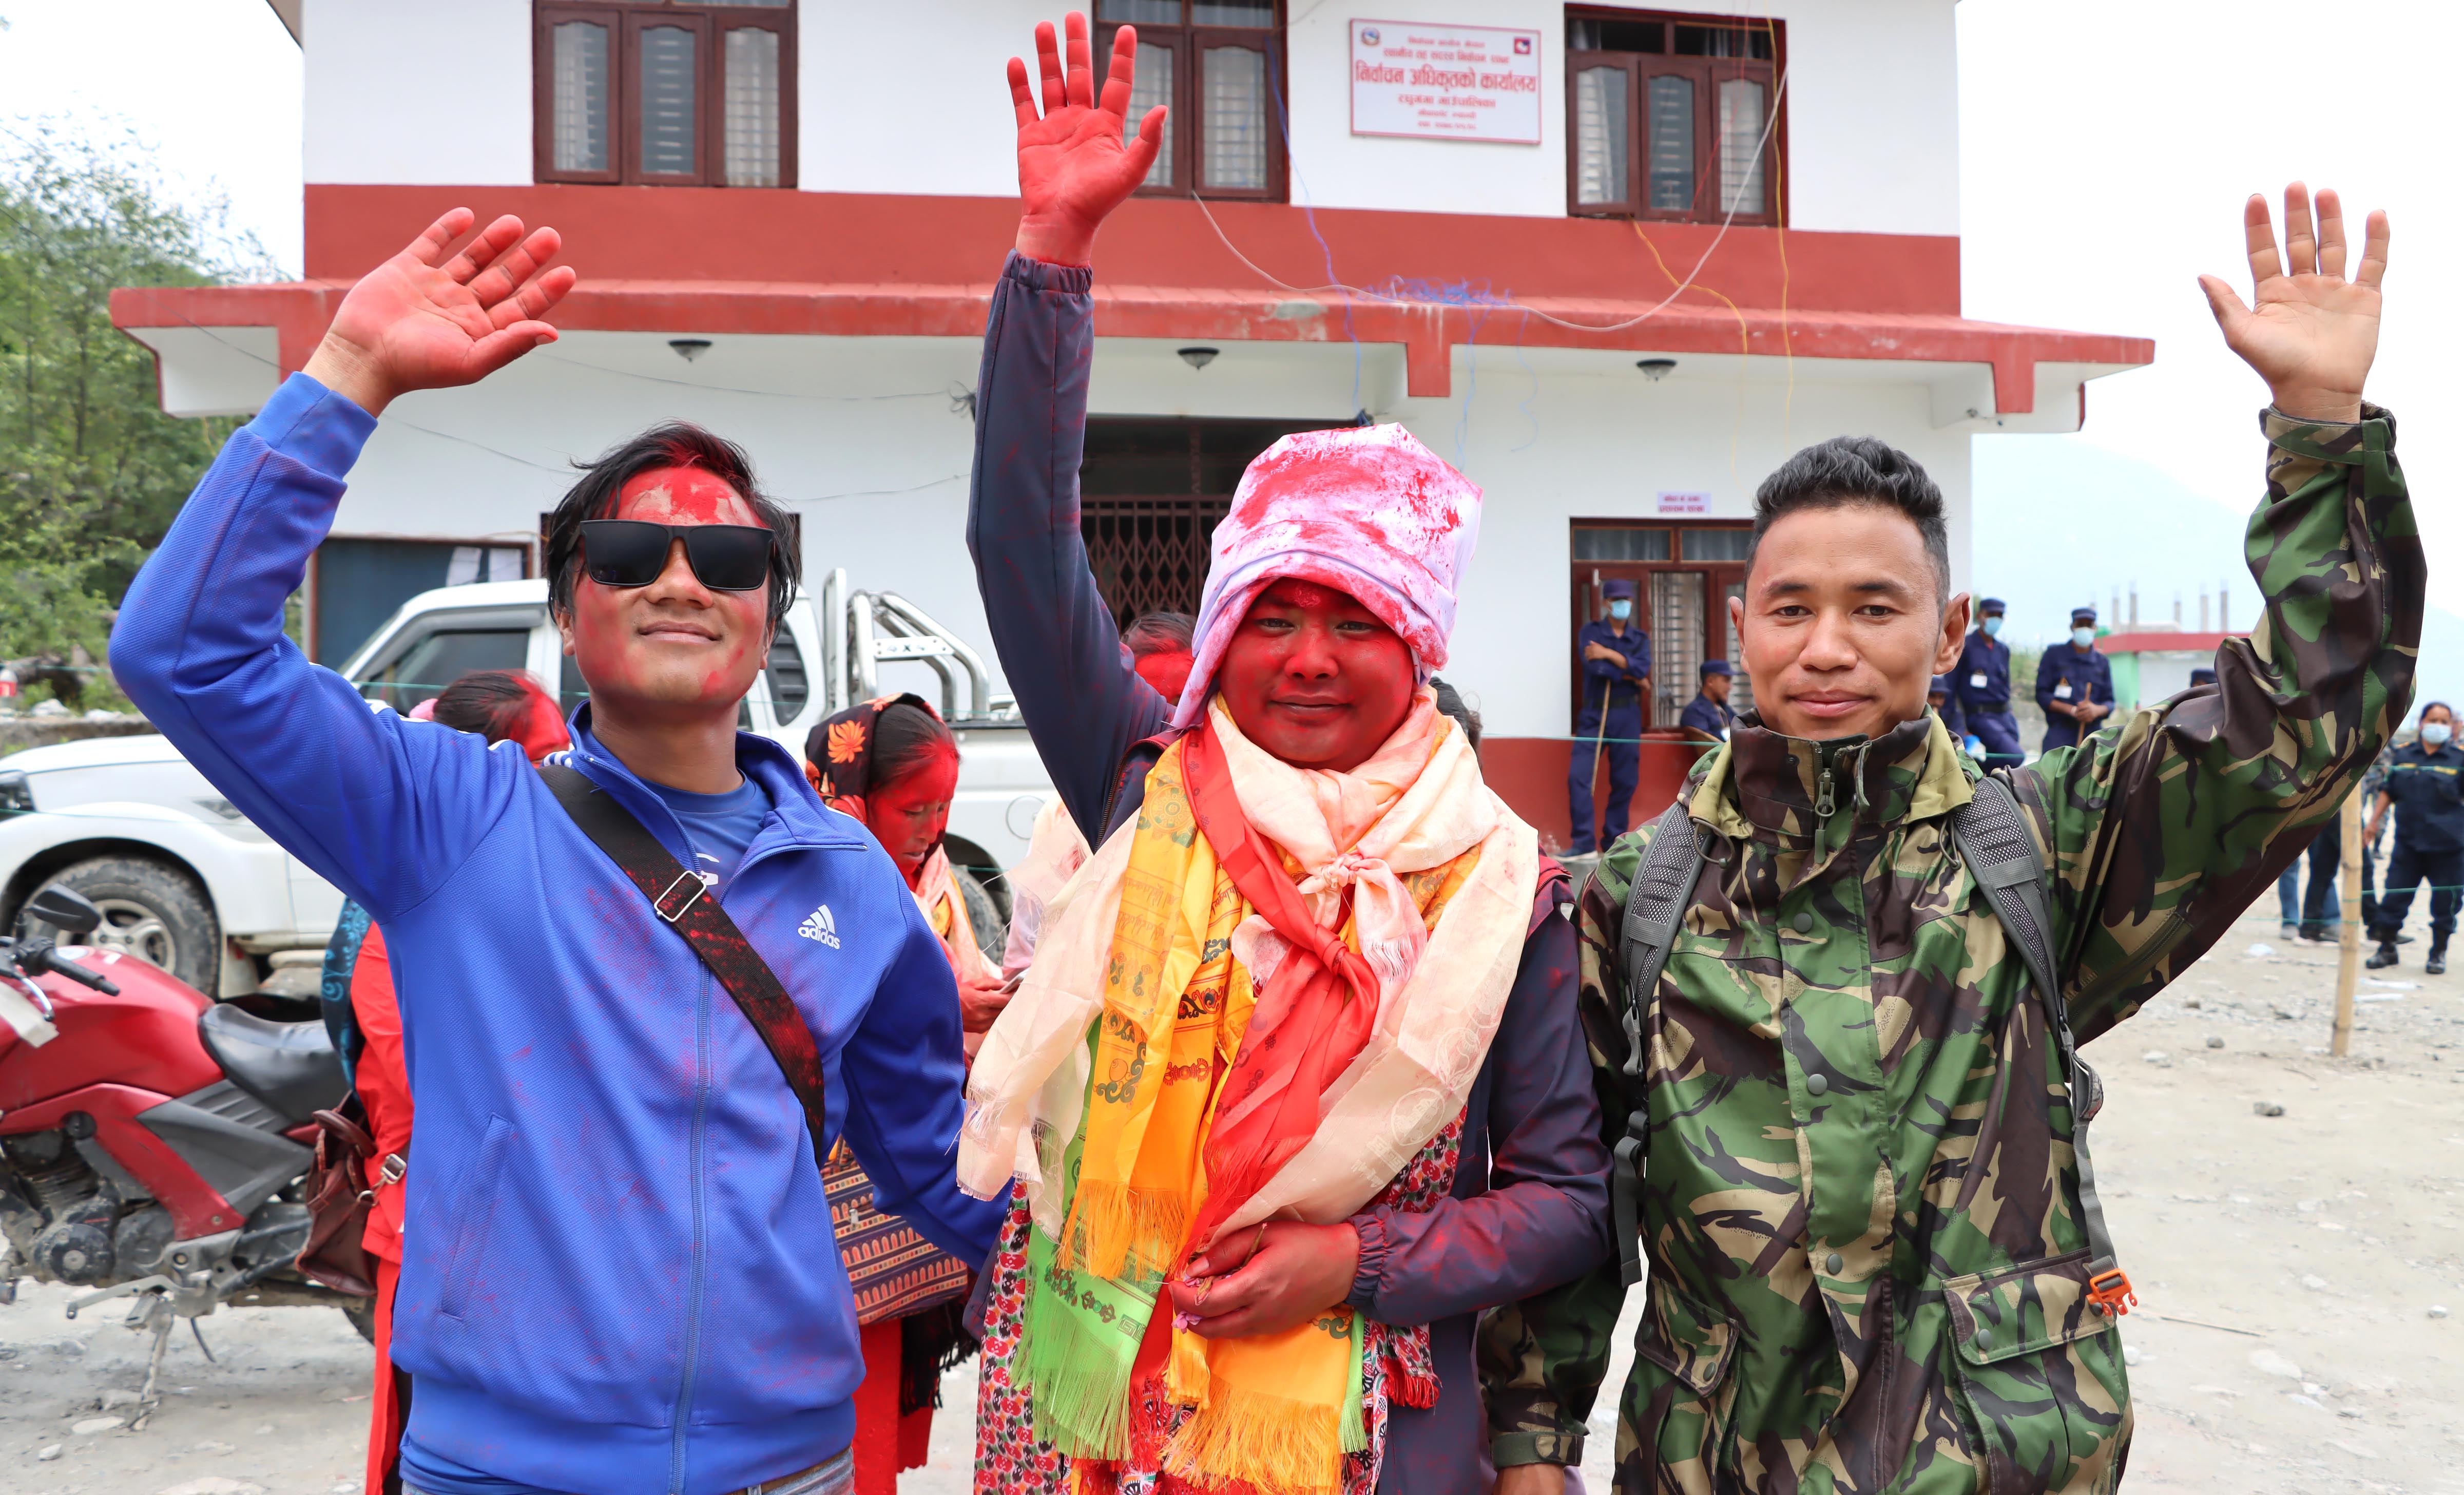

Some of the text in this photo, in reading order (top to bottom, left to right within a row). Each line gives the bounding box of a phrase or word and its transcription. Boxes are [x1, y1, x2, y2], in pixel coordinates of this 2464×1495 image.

[1356, 60, 1536, 92] निर्वाचन अधिकृतको कार्यालय
[798, 926, 840, 950] adidas
